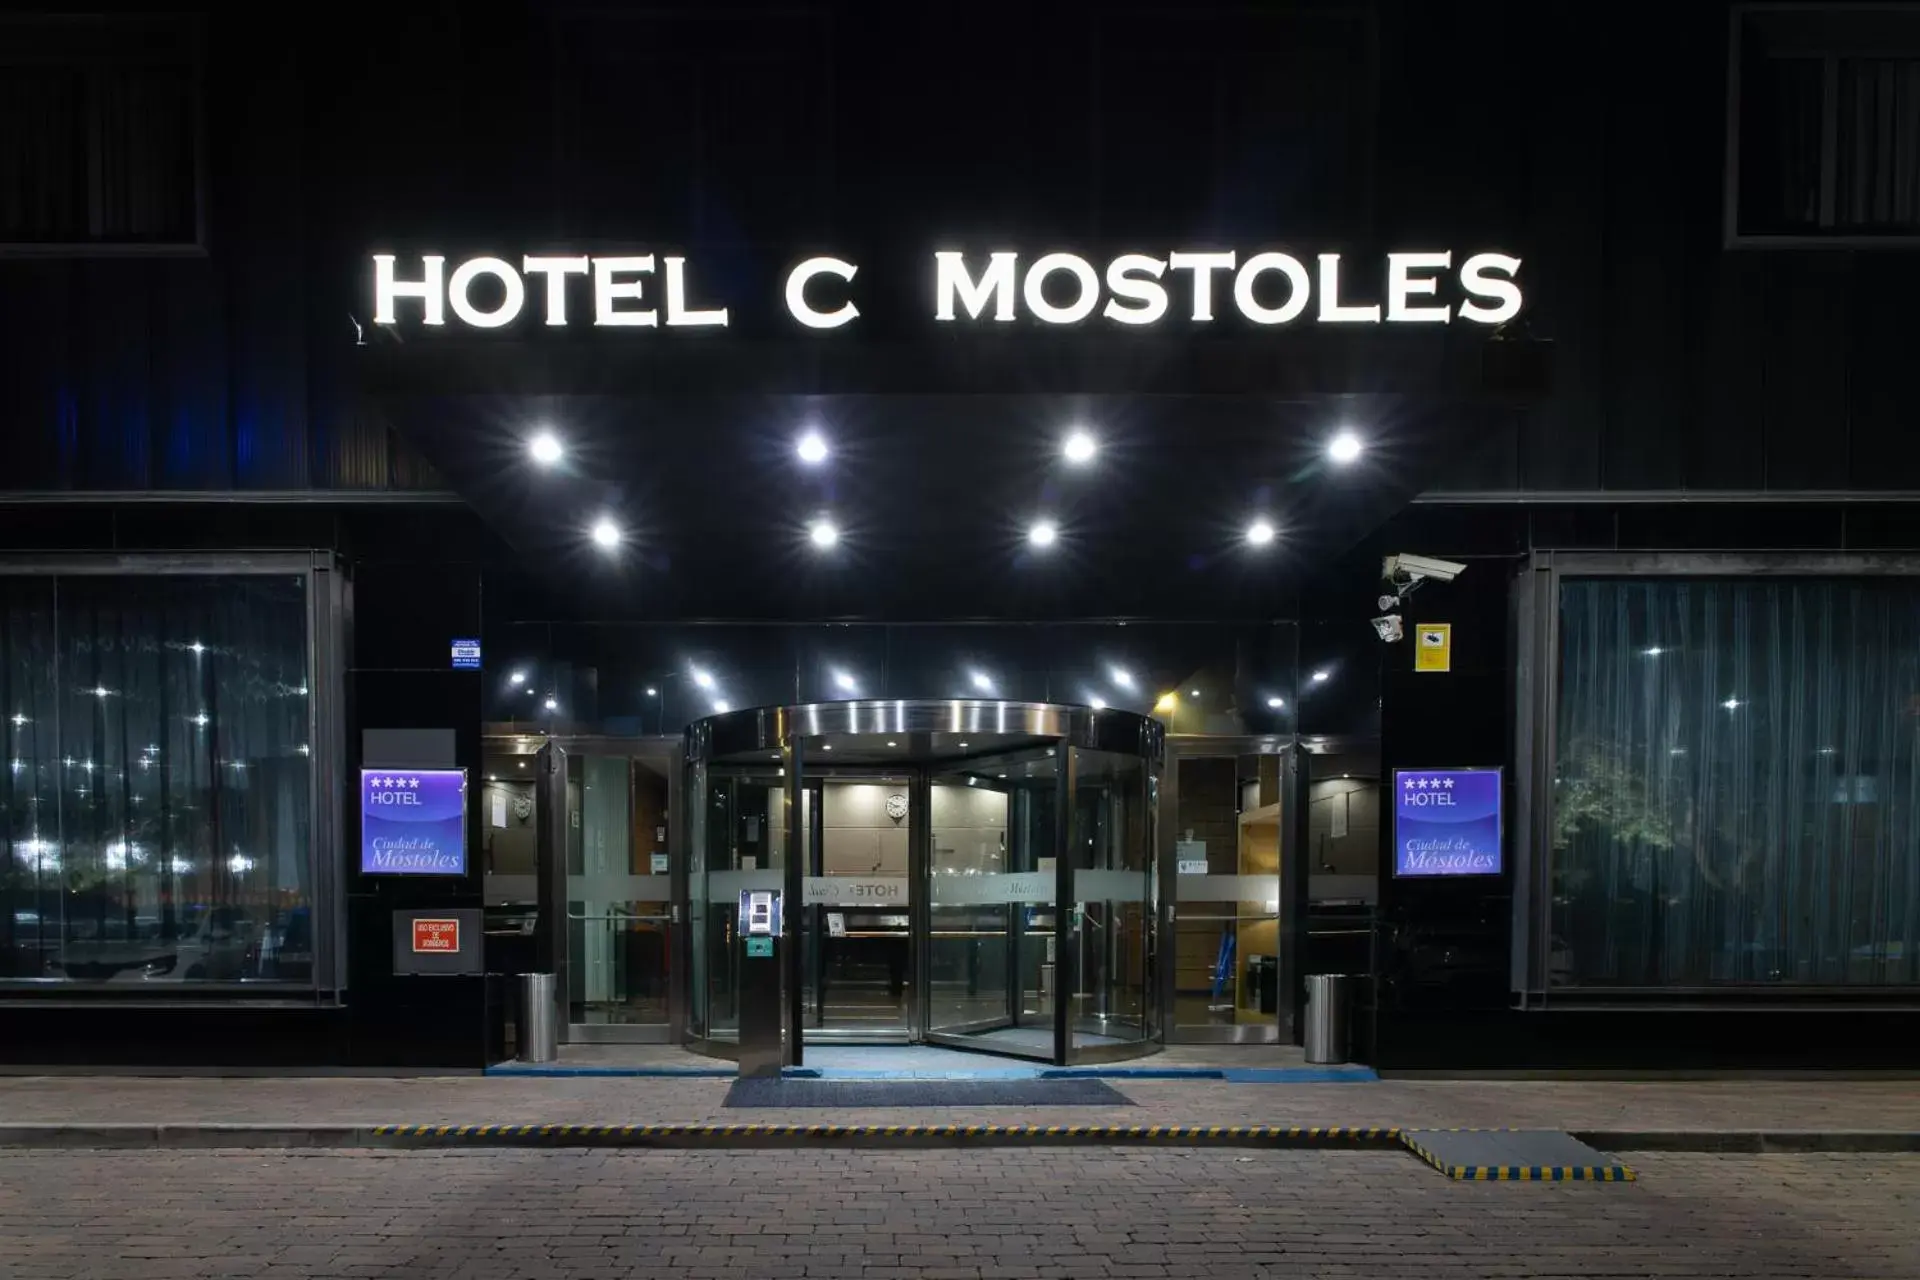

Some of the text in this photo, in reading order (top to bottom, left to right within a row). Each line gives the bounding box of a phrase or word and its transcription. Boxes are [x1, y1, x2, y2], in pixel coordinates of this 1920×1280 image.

[373, 251, 1523, 328] HOTEL C MOSTOLES
[370, 791, 421, 805] HOTEL
[1404, 792, 1456, 806] HOTEL
[372, 837, 434, 850] Ciudad de
[1406, 837, 1470, 851] Ciudad de
